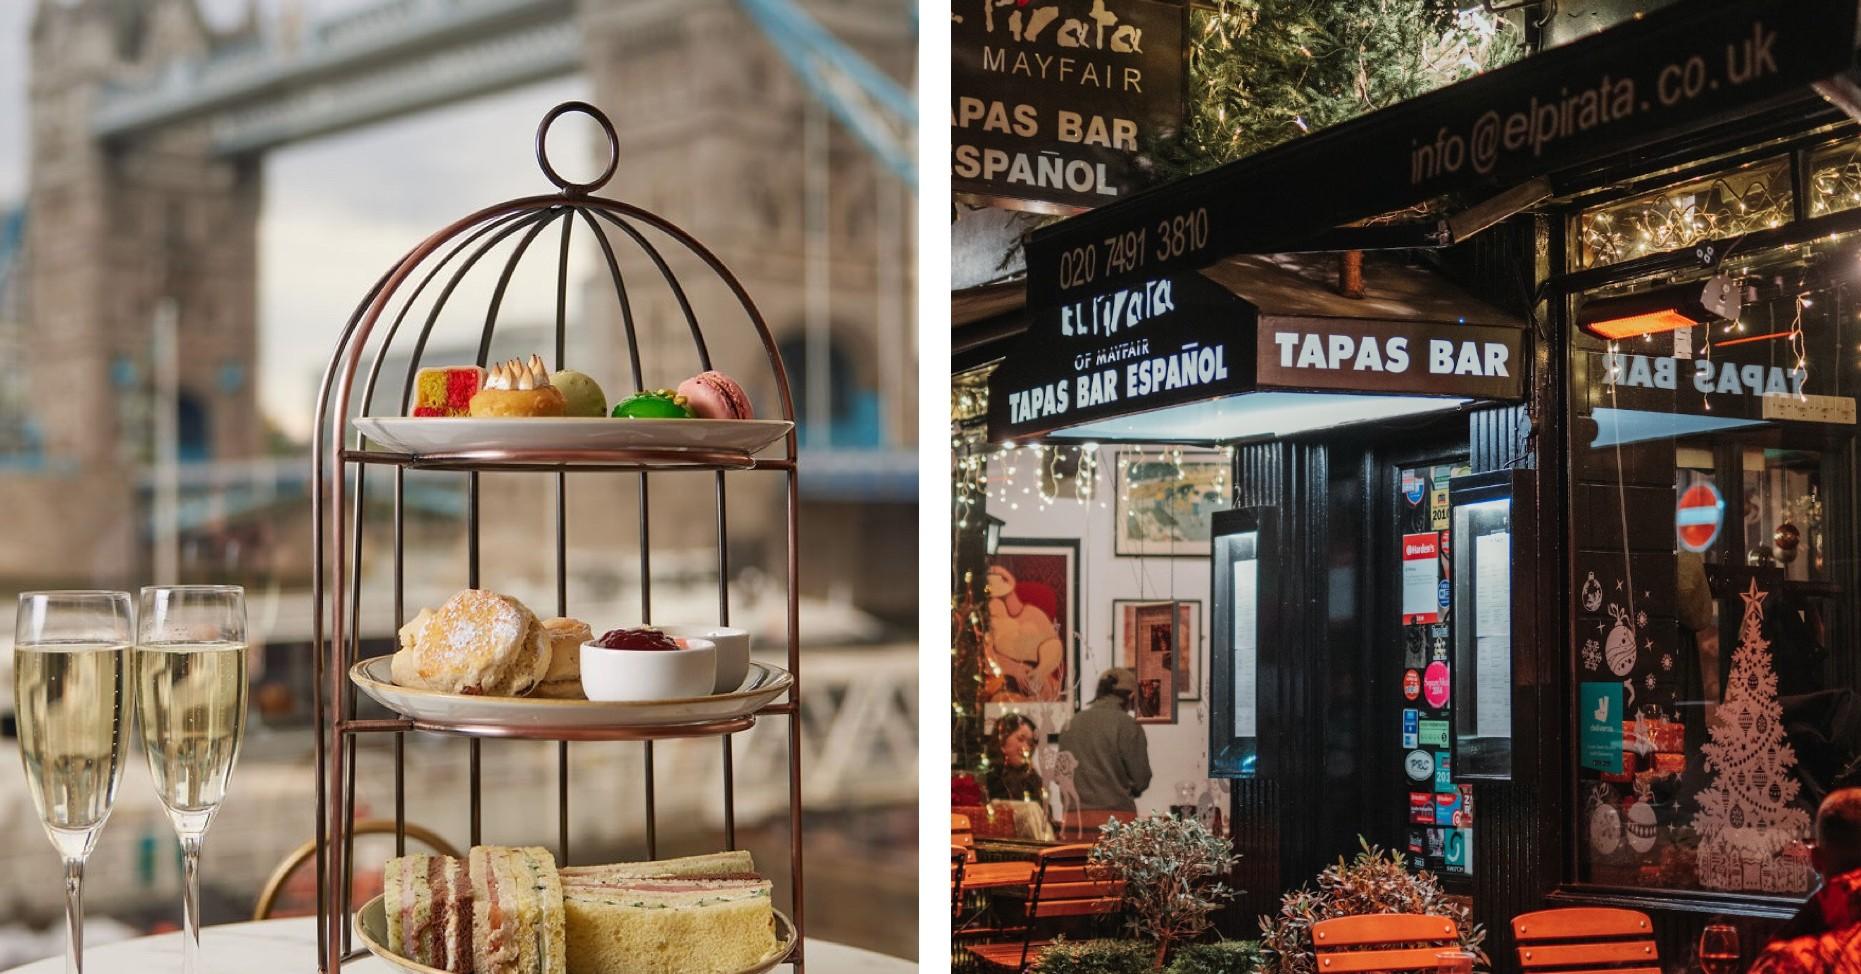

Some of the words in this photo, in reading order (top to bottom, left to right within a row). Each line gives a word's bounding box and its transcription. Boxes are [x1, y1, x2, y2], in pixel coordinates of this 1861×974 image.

[983, 46, 1142, 93] MAYFAIR
[951, 96, 1038, 138] PAS
[1058, 110, 1137, 151] BAR
[951, 144, 1118, 196] SPAÑOL
[1060, 244, 1096, 290] 020
[1104, 228, 1146, 277] 7491
[1156, 207, 1208, 261] 3810
[1074, 353, 1092, 371] OF
[1096, 338, 1149, 366] MAYFAIR
[1275, 332, 1410, 374] TAPAS
[1430, 339, 1509, 377] BAR
[1009, 379, 1069, 424] TAPAS
[1077, 369, 1118, 409] BAR
[1127, 342, 1228, 398] ESPAÑOL
[1436, 771, 1450, 784] 201
